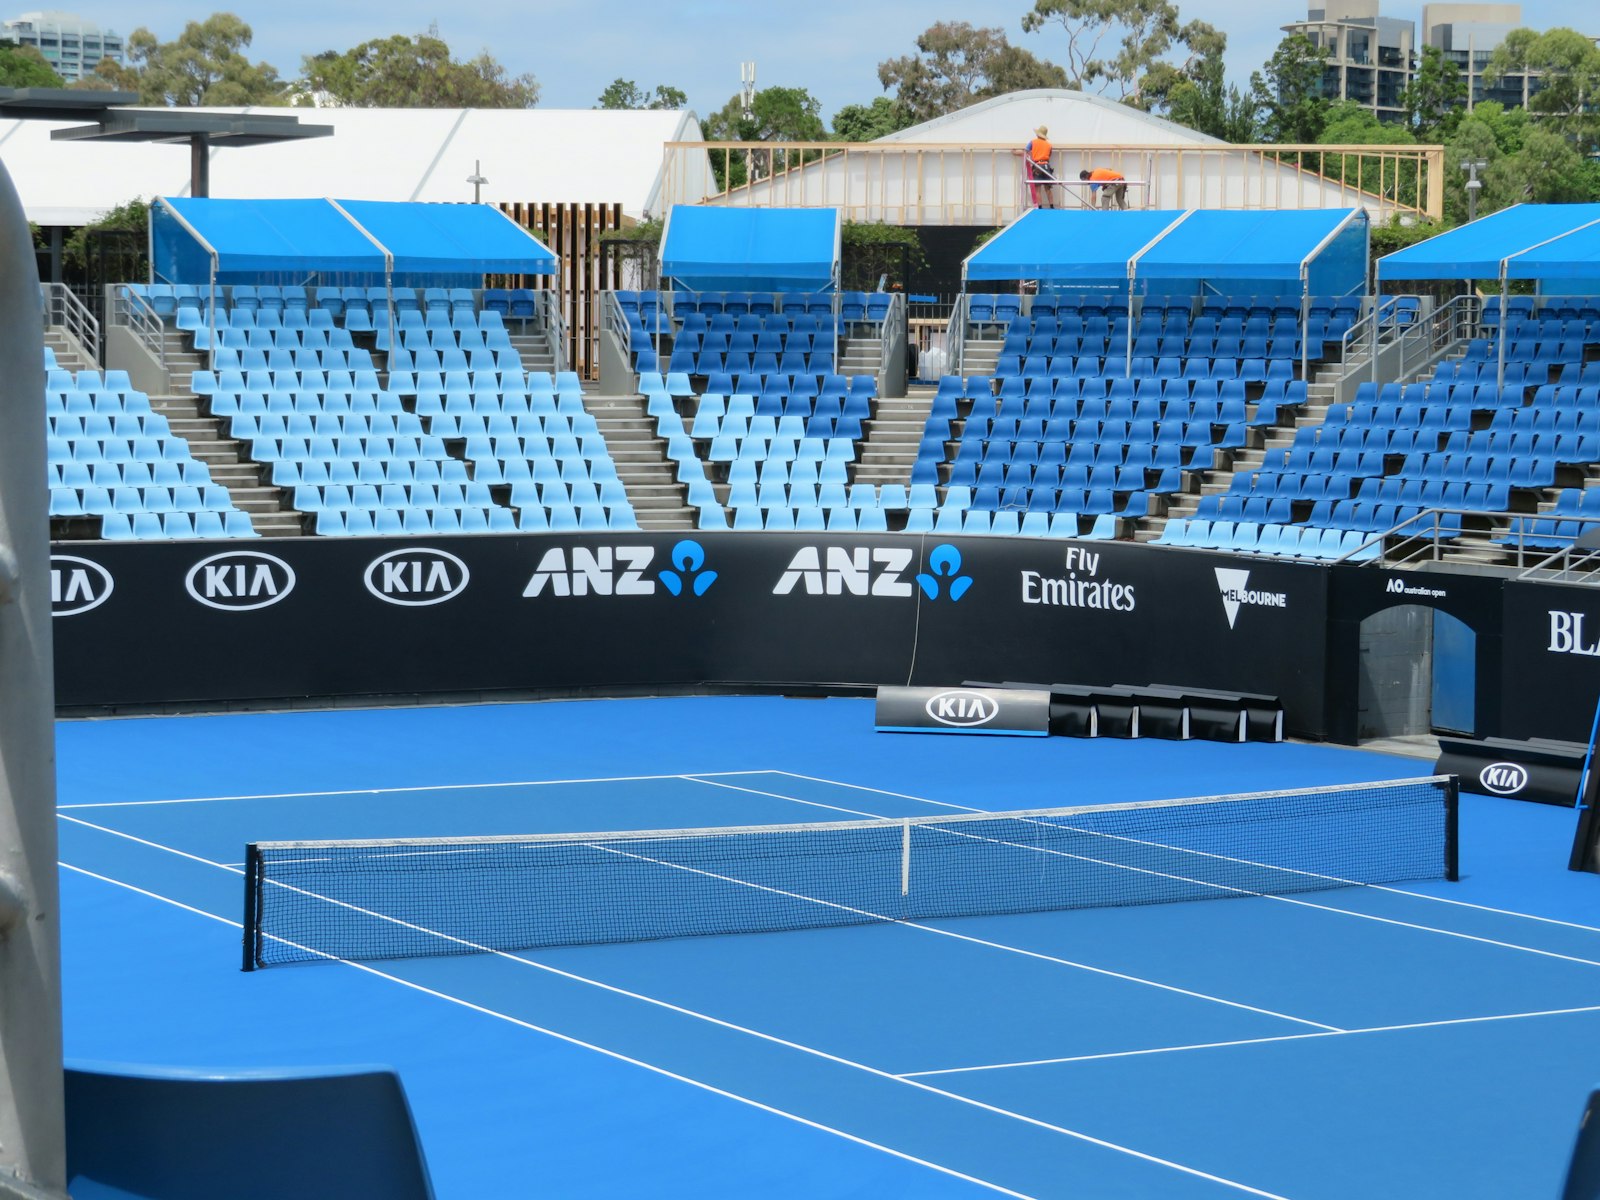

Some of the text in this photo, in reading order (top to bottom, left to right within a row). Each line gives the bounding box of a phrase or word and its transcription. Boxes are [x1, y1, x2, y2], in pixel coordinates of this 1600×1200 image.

[382, 560, 453, 593] KIA
[522, 546, 655, 597] ANZ
[772, 546, 913, 597] ANZ
[1065, 547, 1100, 576] Fly
[50, 569, 96, 602] IA
[205, 564, 278, 598] KIA
[1020, 571, 1136, 612] Emirates
[1385, 578, 1446, 598] AO australian open
[1221, 589, 1286, 607] MELBOURNE
[938, 697, 986, 719] KIA
[1486, 767, 1519, 788] KIA
